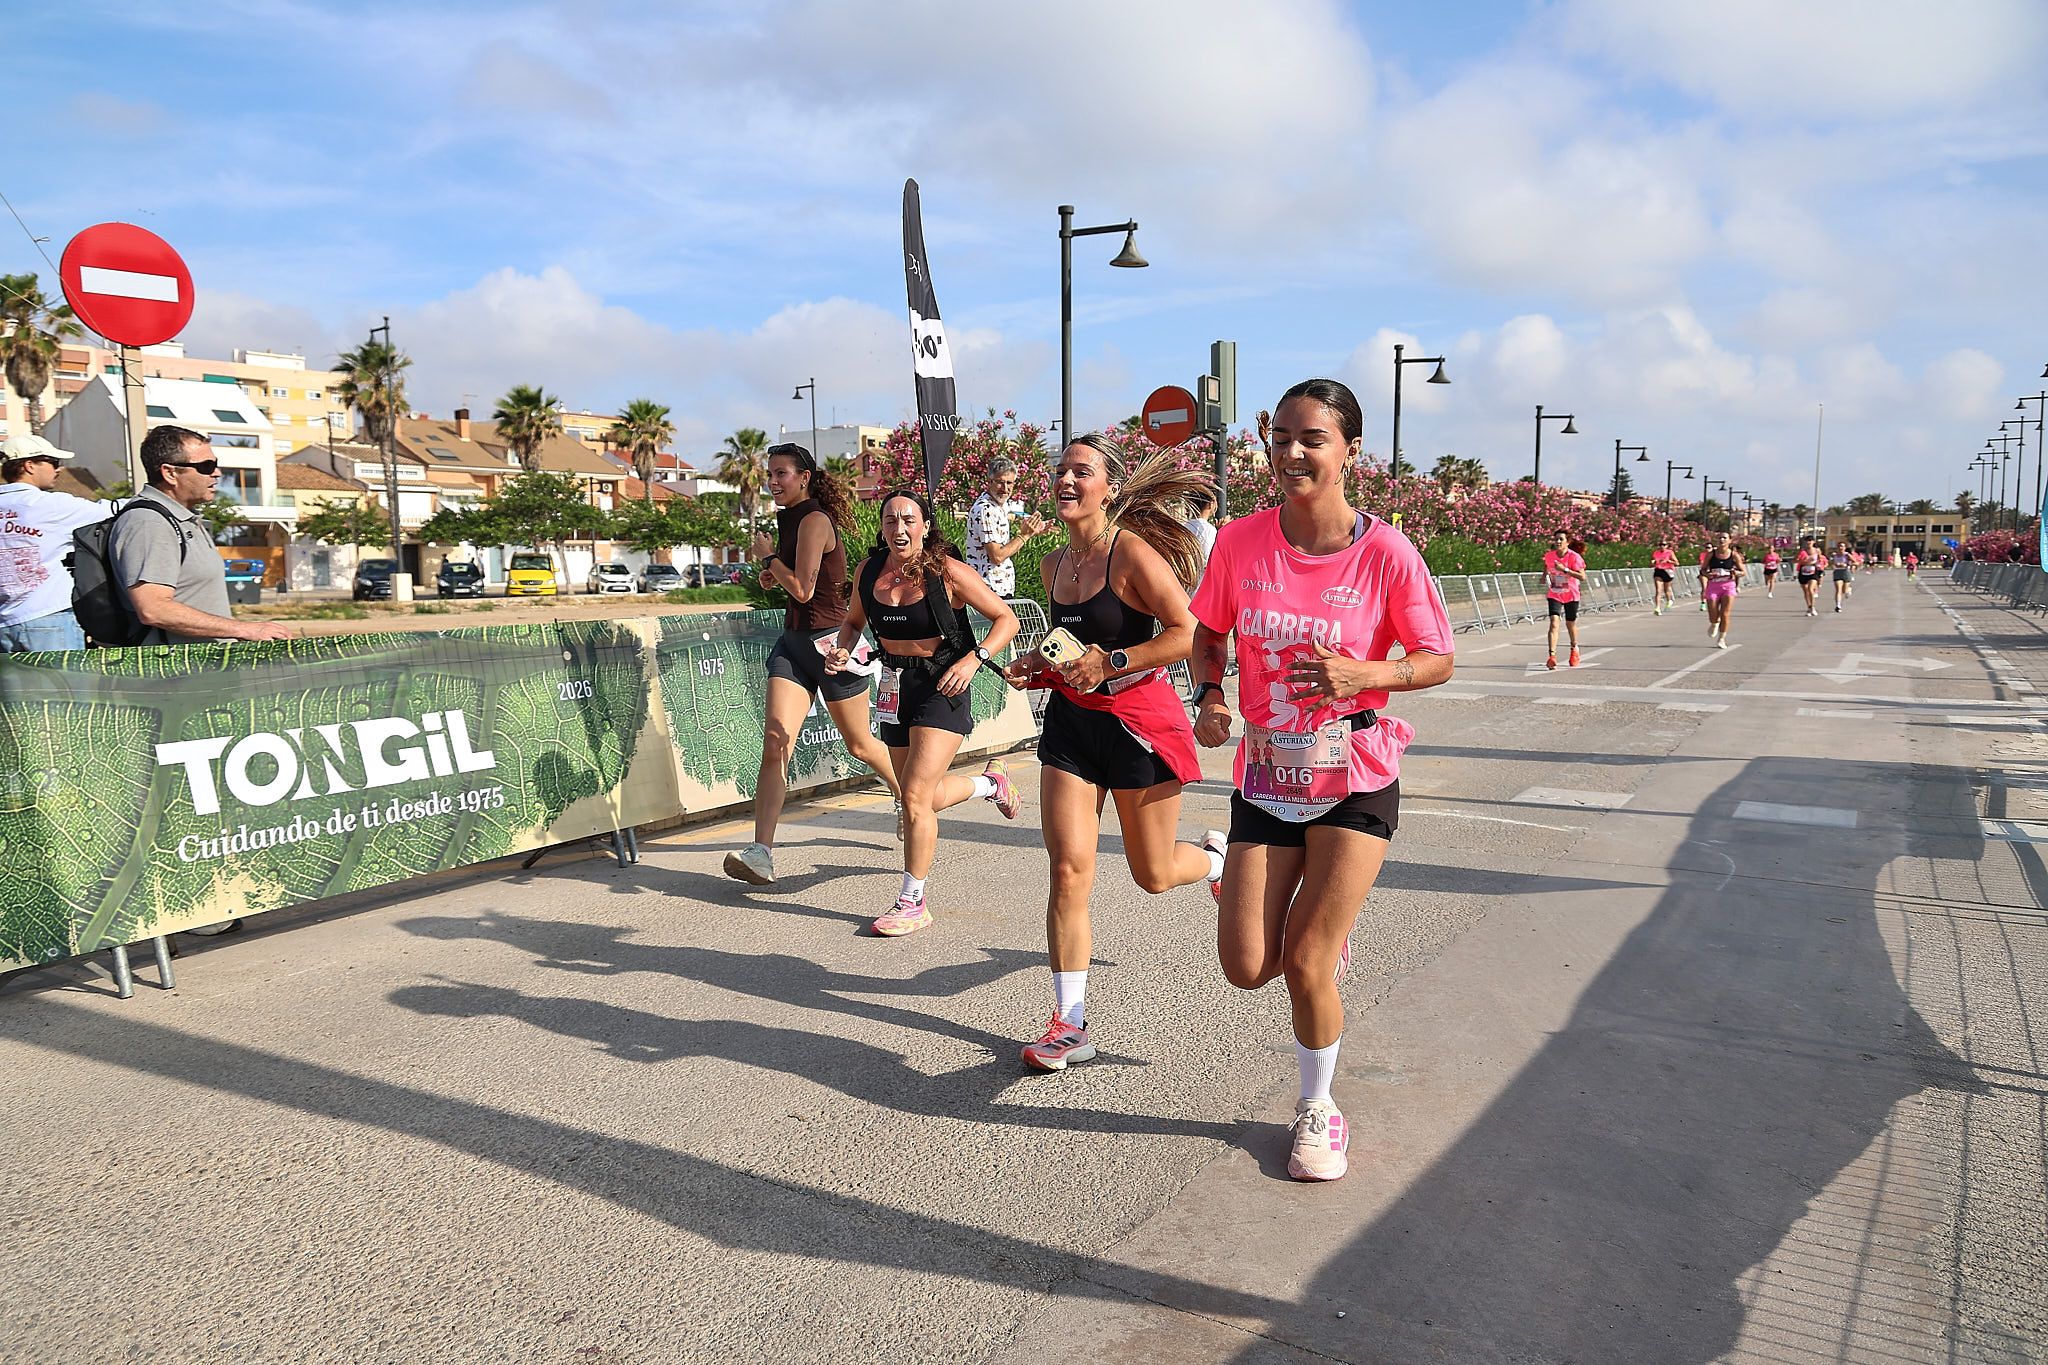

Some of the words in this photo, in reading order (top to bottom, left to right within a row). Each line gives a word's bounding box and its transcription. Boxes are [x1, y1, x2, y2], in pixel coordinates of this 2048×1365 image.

[1241, 578, 1284, 594] OYSHO
[1061, 615, 1082, 623] OYSHO
[1240, 607, 1342, 650] CARRERA
[698, 658, 724, 676] 1975
[557, 680, 592, 701] 2026
[802, 723, 843, 746] Cuida
[1275, 767, 1314, 785] 016
[1252, 792, 1277, 802] CARRERA
[1292, 796, 1308, 804] MUJER
[178, 815, 321, 862] Cuidando
[327, 806, 357, 836] de
[361, 802, 382, 828] ti
[385, 791, 453, 824] desde
[457, 786, 504, 813] 1975
